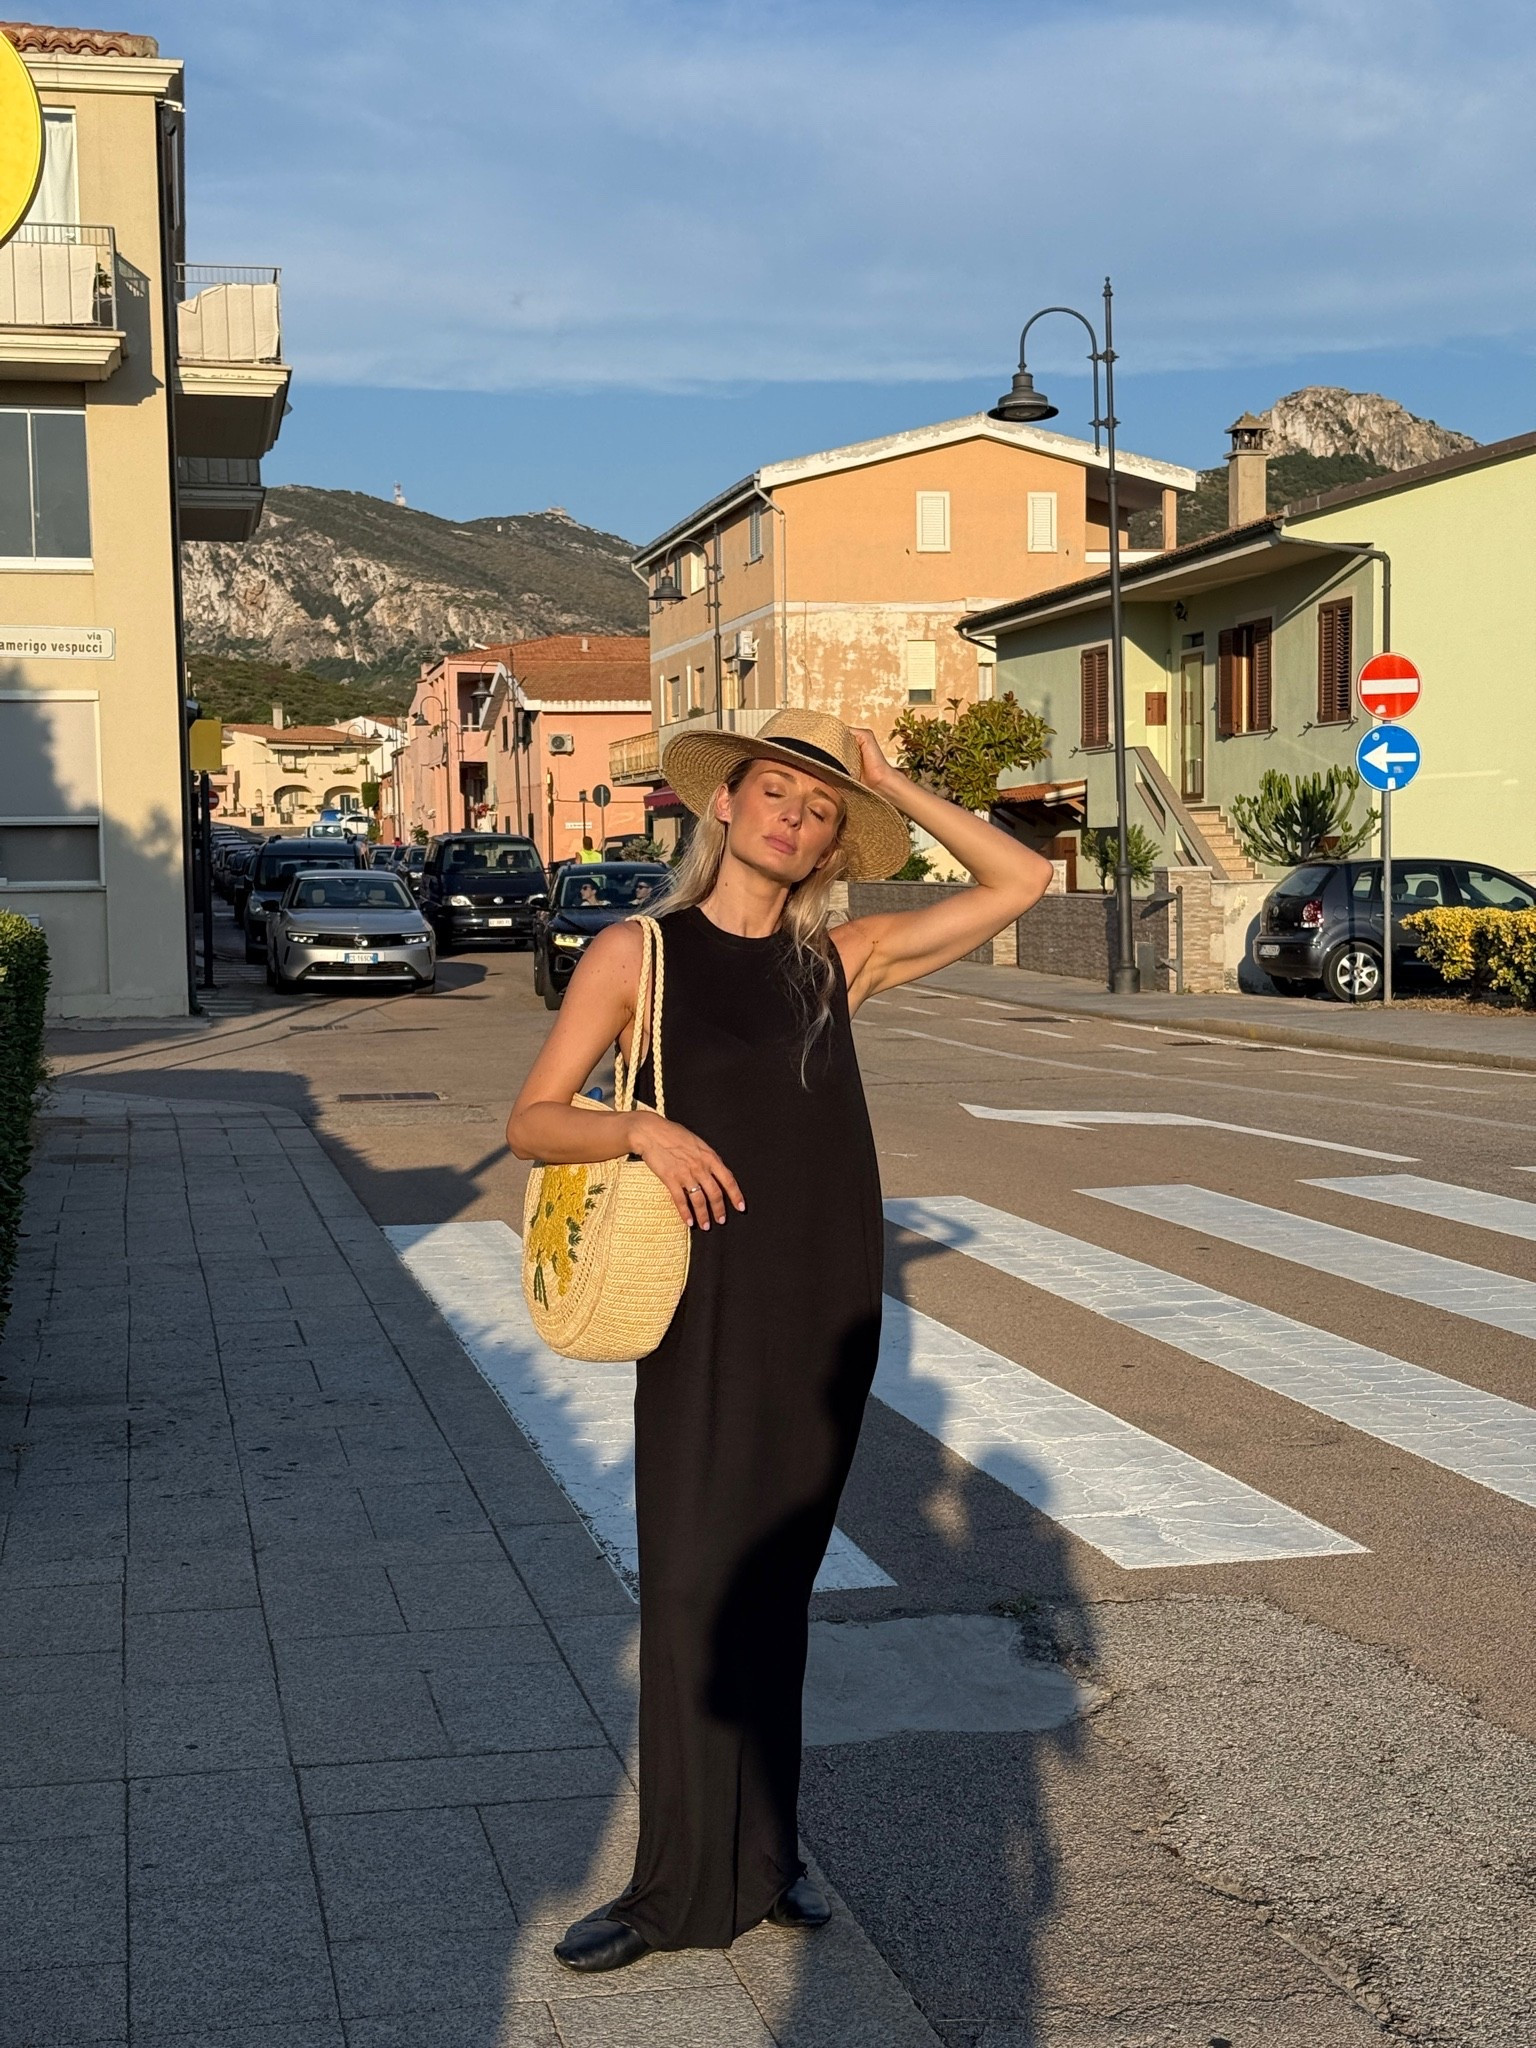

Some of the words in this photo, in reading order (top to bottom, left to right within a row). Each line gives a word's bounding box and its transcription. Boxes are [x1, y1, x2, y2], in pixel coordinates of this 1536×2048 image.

[86, 632, 102, 640] via
[0, 639, 47, 654] amerigo
[51, 641, 102, 655] vespucci
